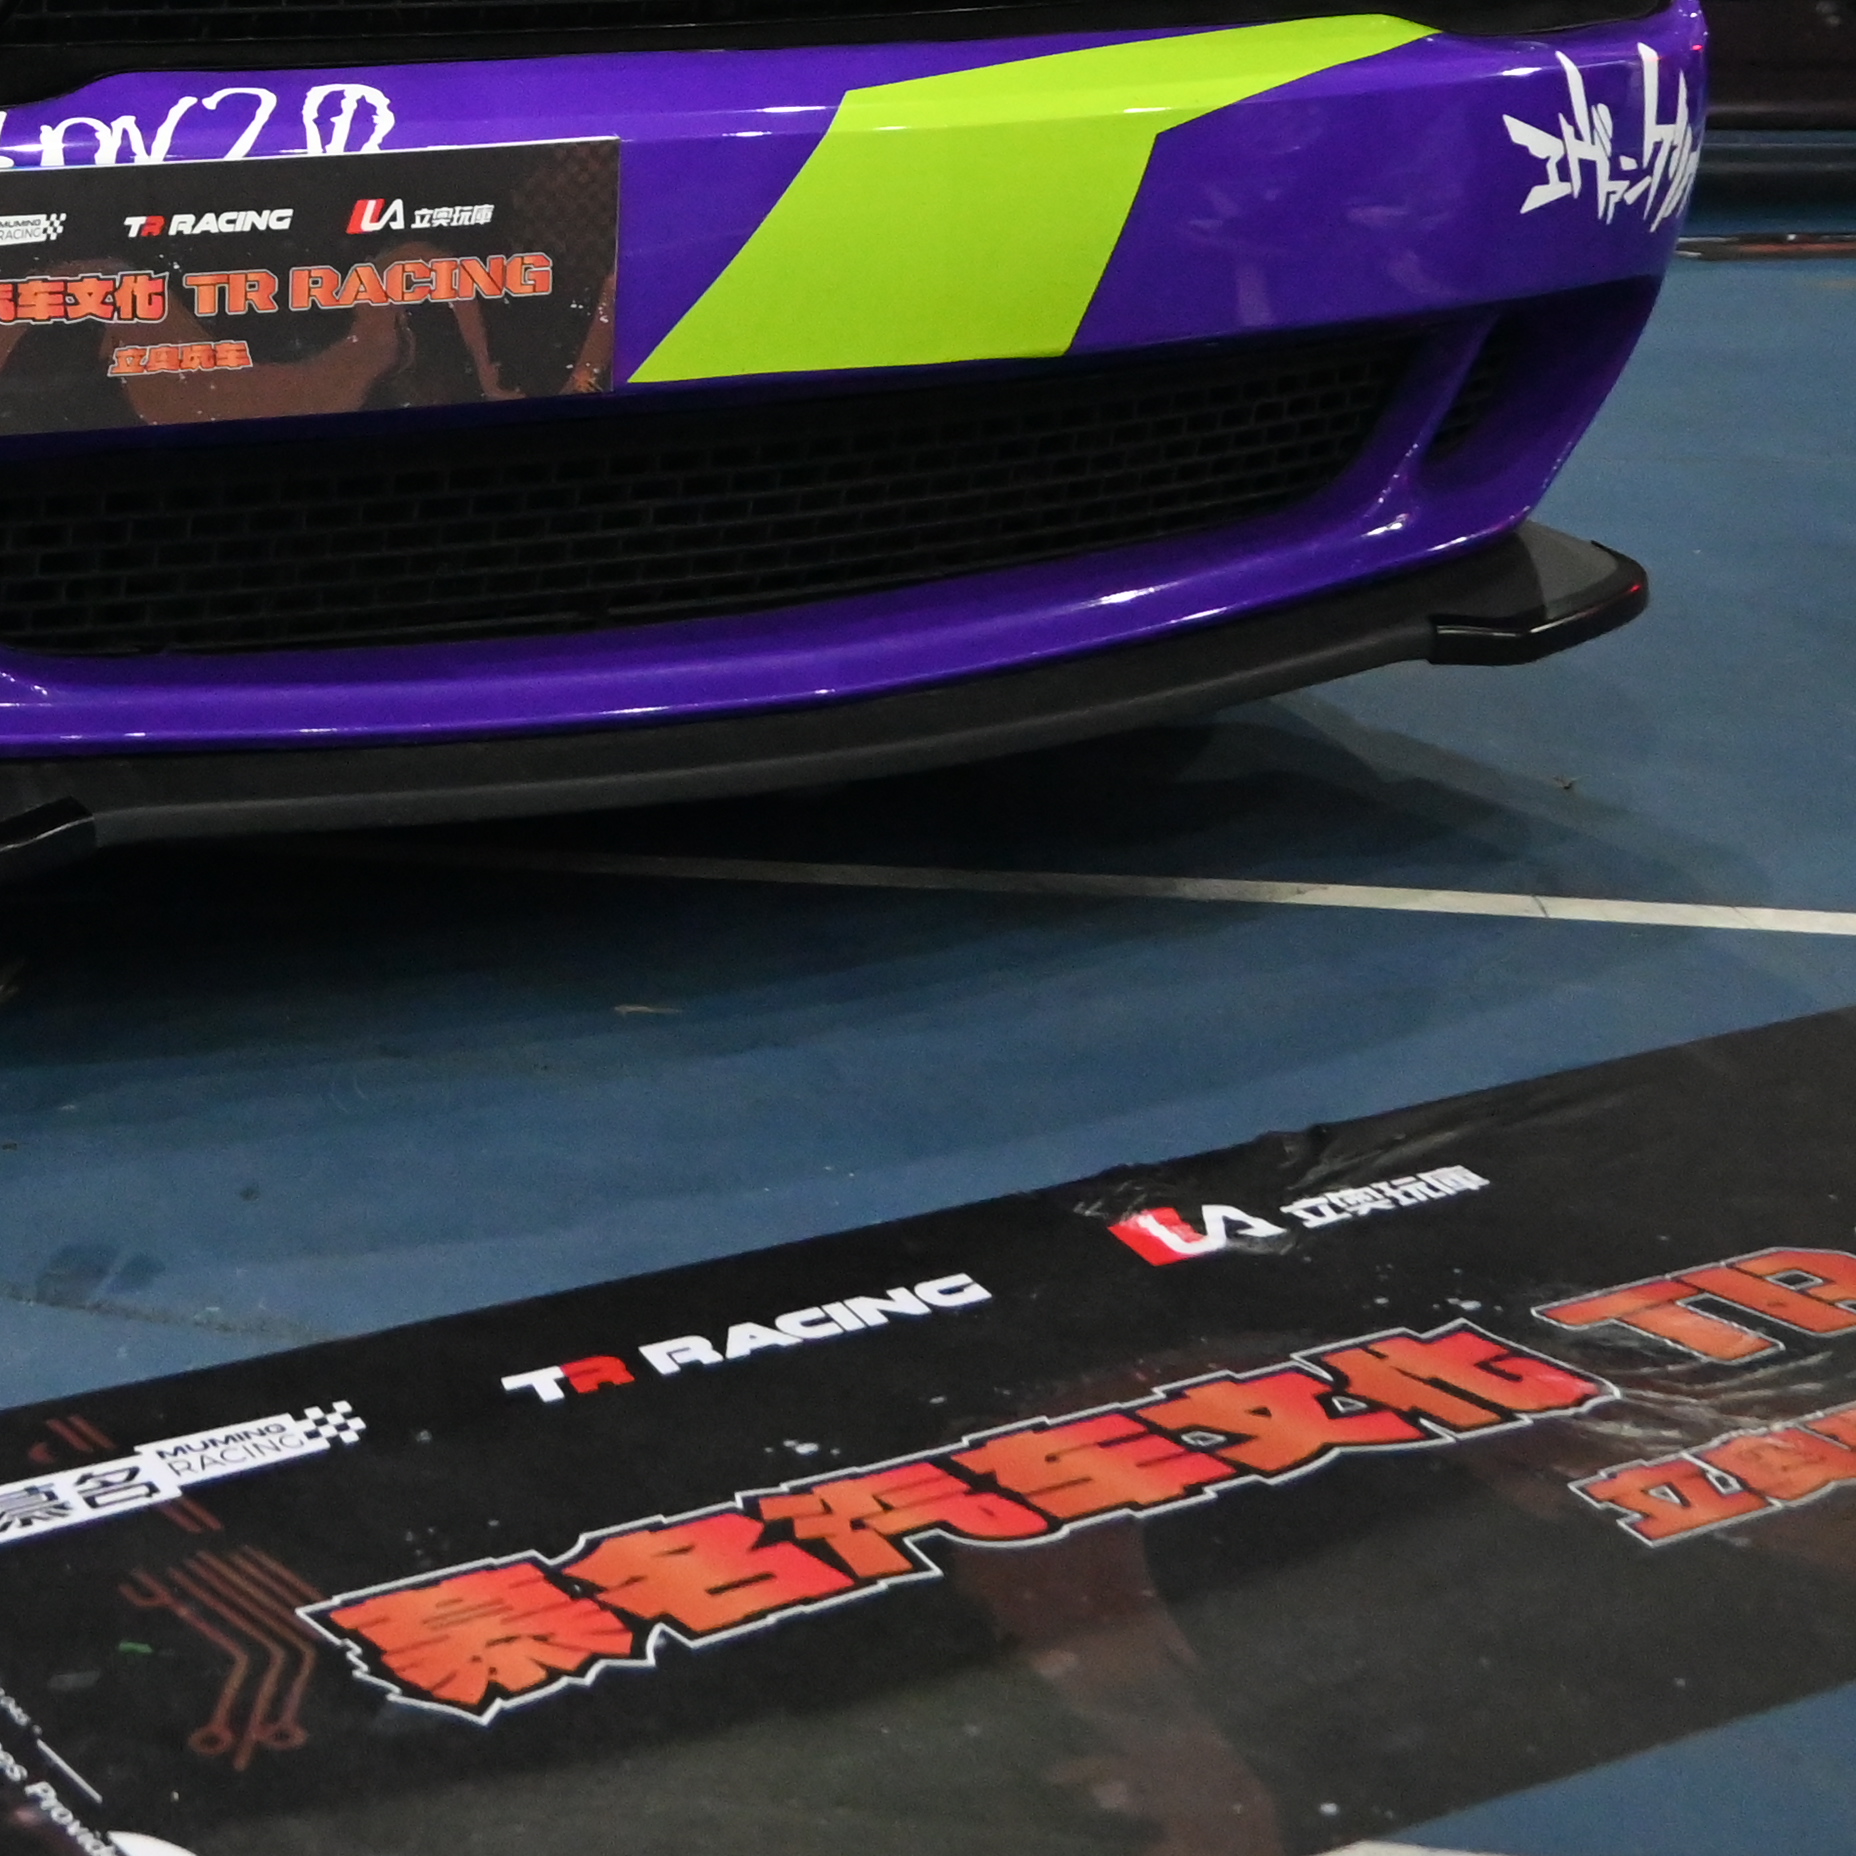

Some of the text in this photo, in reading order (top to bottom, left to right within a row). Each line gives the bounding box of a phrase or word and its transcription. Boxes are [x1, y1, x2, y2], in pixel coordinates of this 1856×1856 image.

[123, 208, 294, 238] TR RACING
[182, 269, 279, 317] TR
[288, 252, 553, 313] RACING
[501, 1272, 993, 1403] TR RACING
[155, 1423, 288, 1461] MUMING
[166, 1435, 307, 1477] RACING
[296, 1319, 1623, 1725] 慕名汽车文化
[24, 1780, 117, 1856] Provi
